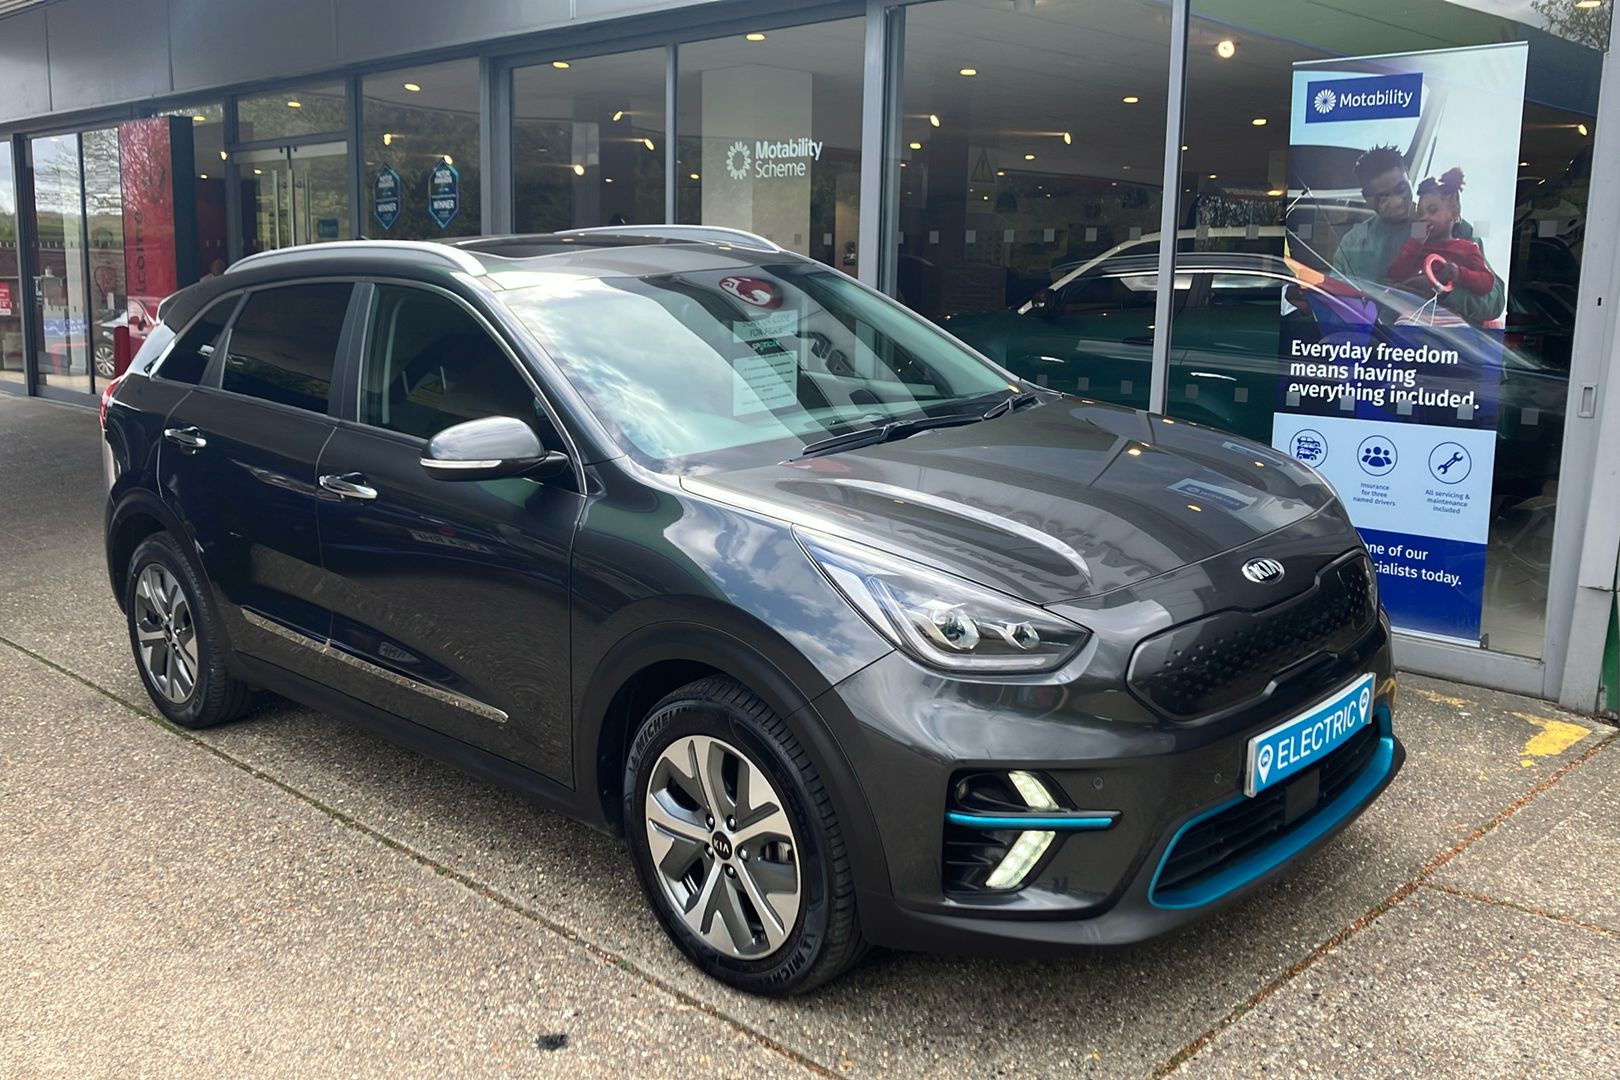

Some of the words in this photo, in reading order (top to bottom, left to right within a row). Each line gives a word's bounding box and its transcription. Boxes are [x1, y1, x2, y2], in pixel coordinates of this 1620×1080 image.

[1339, 88, 1413, 108] Motability
[755, 138, 823, 161] Motability
[755, 160, 806, 178] Scheme
[1291, 340, 1372, 363] Everyday
[1377, 343, 1458, 364] freedom
[1290, 362, 1349, 379] means
[1353, 363, 1417, 387] having
[1289, 383, 1385, 406] everything
[1390, 385, 1480, 410] included.
[1360, 482, 1390, 490] Insurance
[1353, 496, 1374, 504] named
[1375, 498, 1396, 507] drivers
[1427, 497, 1468, 507] maintenance
[1435, 490, 1464, 501] servicing
[1433, 505, 1461, 514] included
[1388, 545, 1403, 557] of
[1405, 549, 1429, 561] our
[1248, 559, 1281, 580] KIA
[1421, 568, 1462, 587] today.
[1277, 700, 1357, 770] ELECTRIC
[713, 838, 730, 854] KIA
